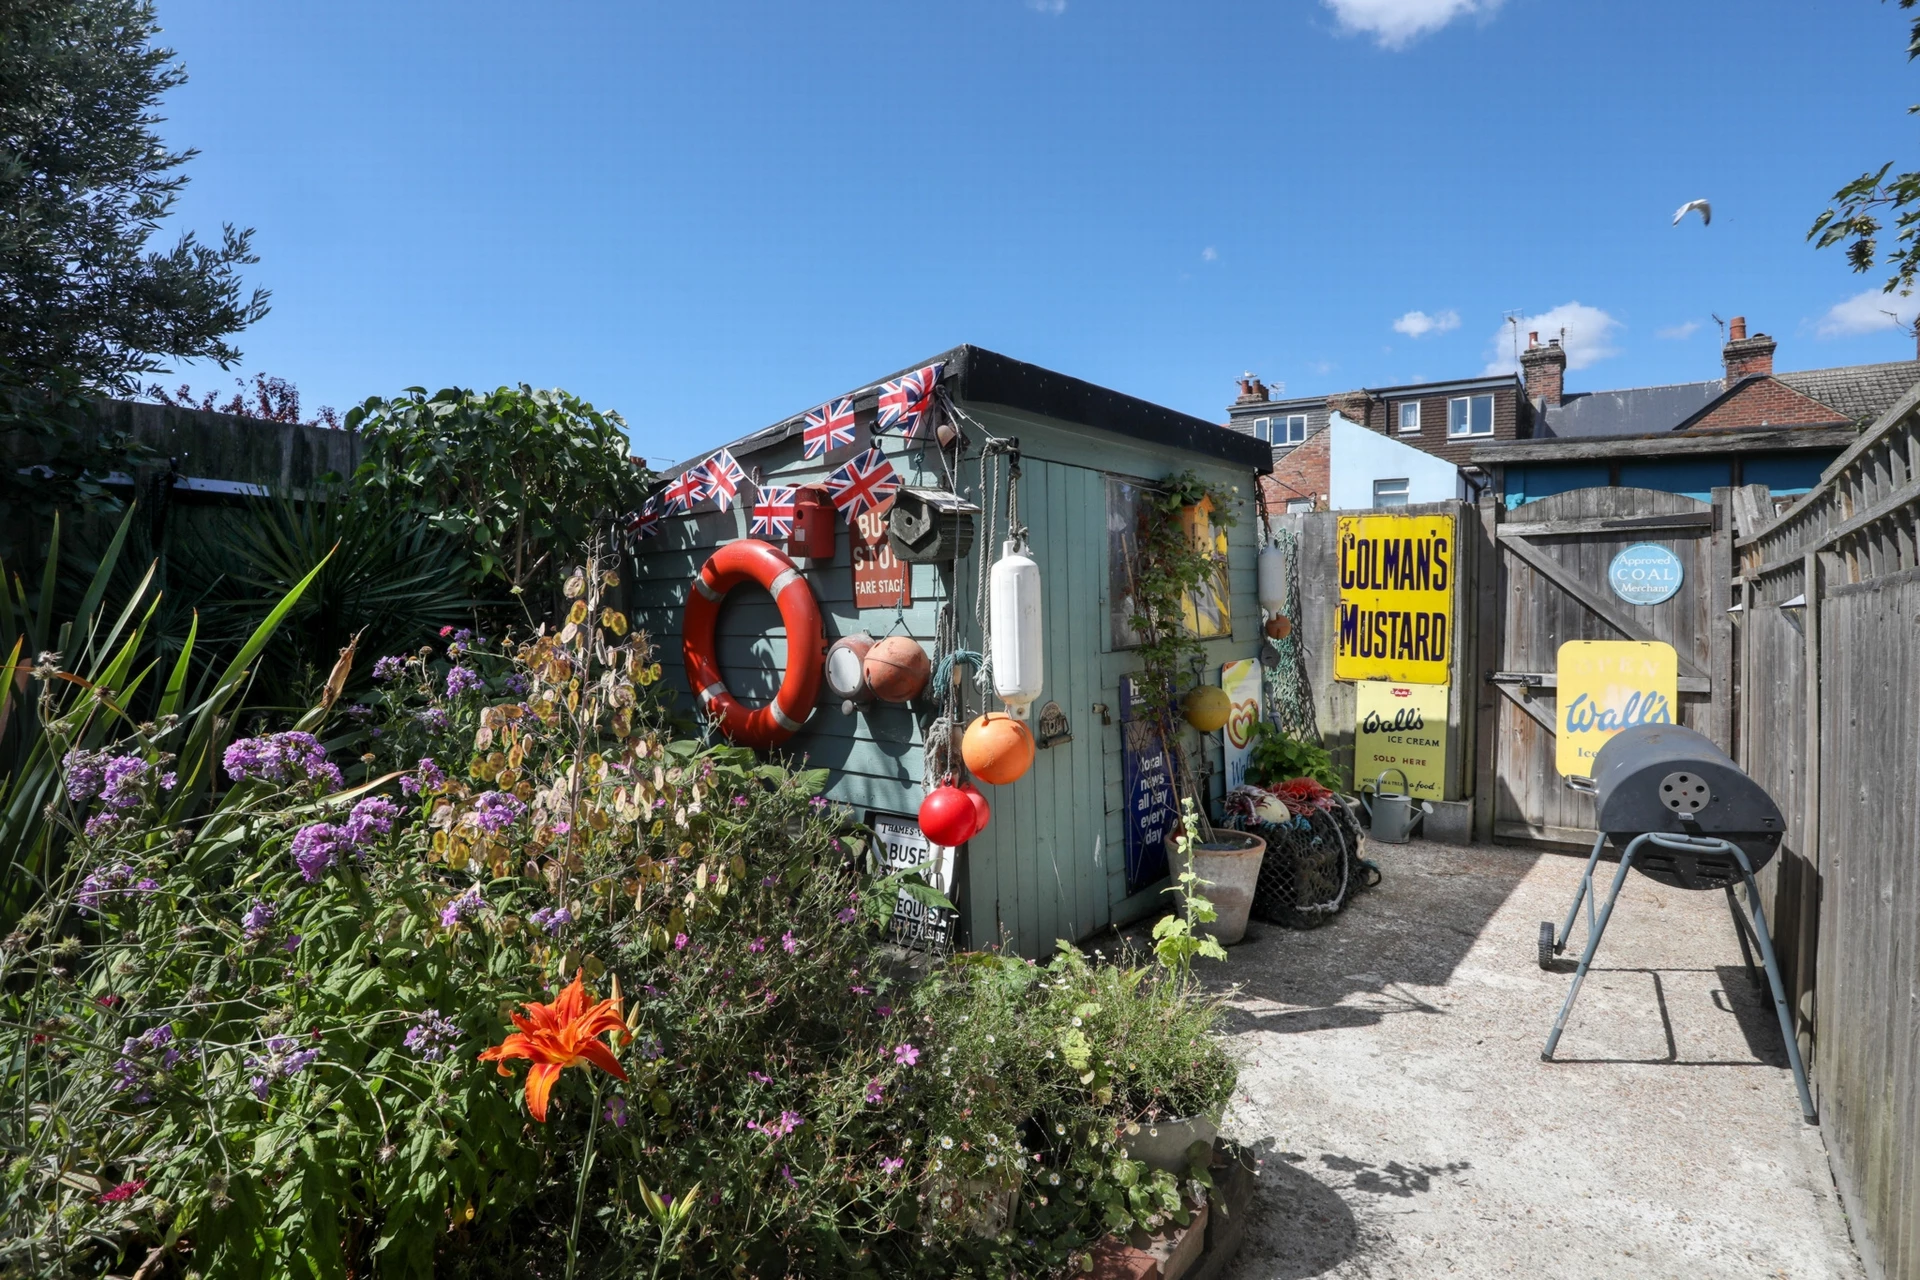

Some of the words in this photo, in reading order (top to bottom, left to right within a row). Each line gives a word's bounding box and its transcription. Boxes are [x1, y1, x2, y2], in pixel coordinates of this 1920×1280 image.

[859, 512, 889, 539] BU
[1341, 529, 1448, 591] COLMAN'S
[1618, 555, 1671, 567] Approved
[1617, 568, 1674, 580] COAL
[855, 580, 877, 595] FARE
[1621, 582, 1669, 593] Merchant
[1340, 604, 1447, 661] MUSTARD
[1362, 707, 1424, 734] Wall's
[1565, 690, 1671, 733] Wall's
[1387, 735, 1403, 744] ICE
[1406, 736, 1440, 747] CREAM
[1373, 754, 1396, 763] SOLD
[1402, 757, 1427, 767] HERE
[1577, 747, 1598, 758] Ice
[1141, 751, 1163, 773] local
[1414, 780, 1435, 791] food
[1138, 792, 1150, 811] all
[1140, 808, 1167, 829] every
[1145, 827, 1163, 845] day
[889, 842, 927, 865] BUSE
